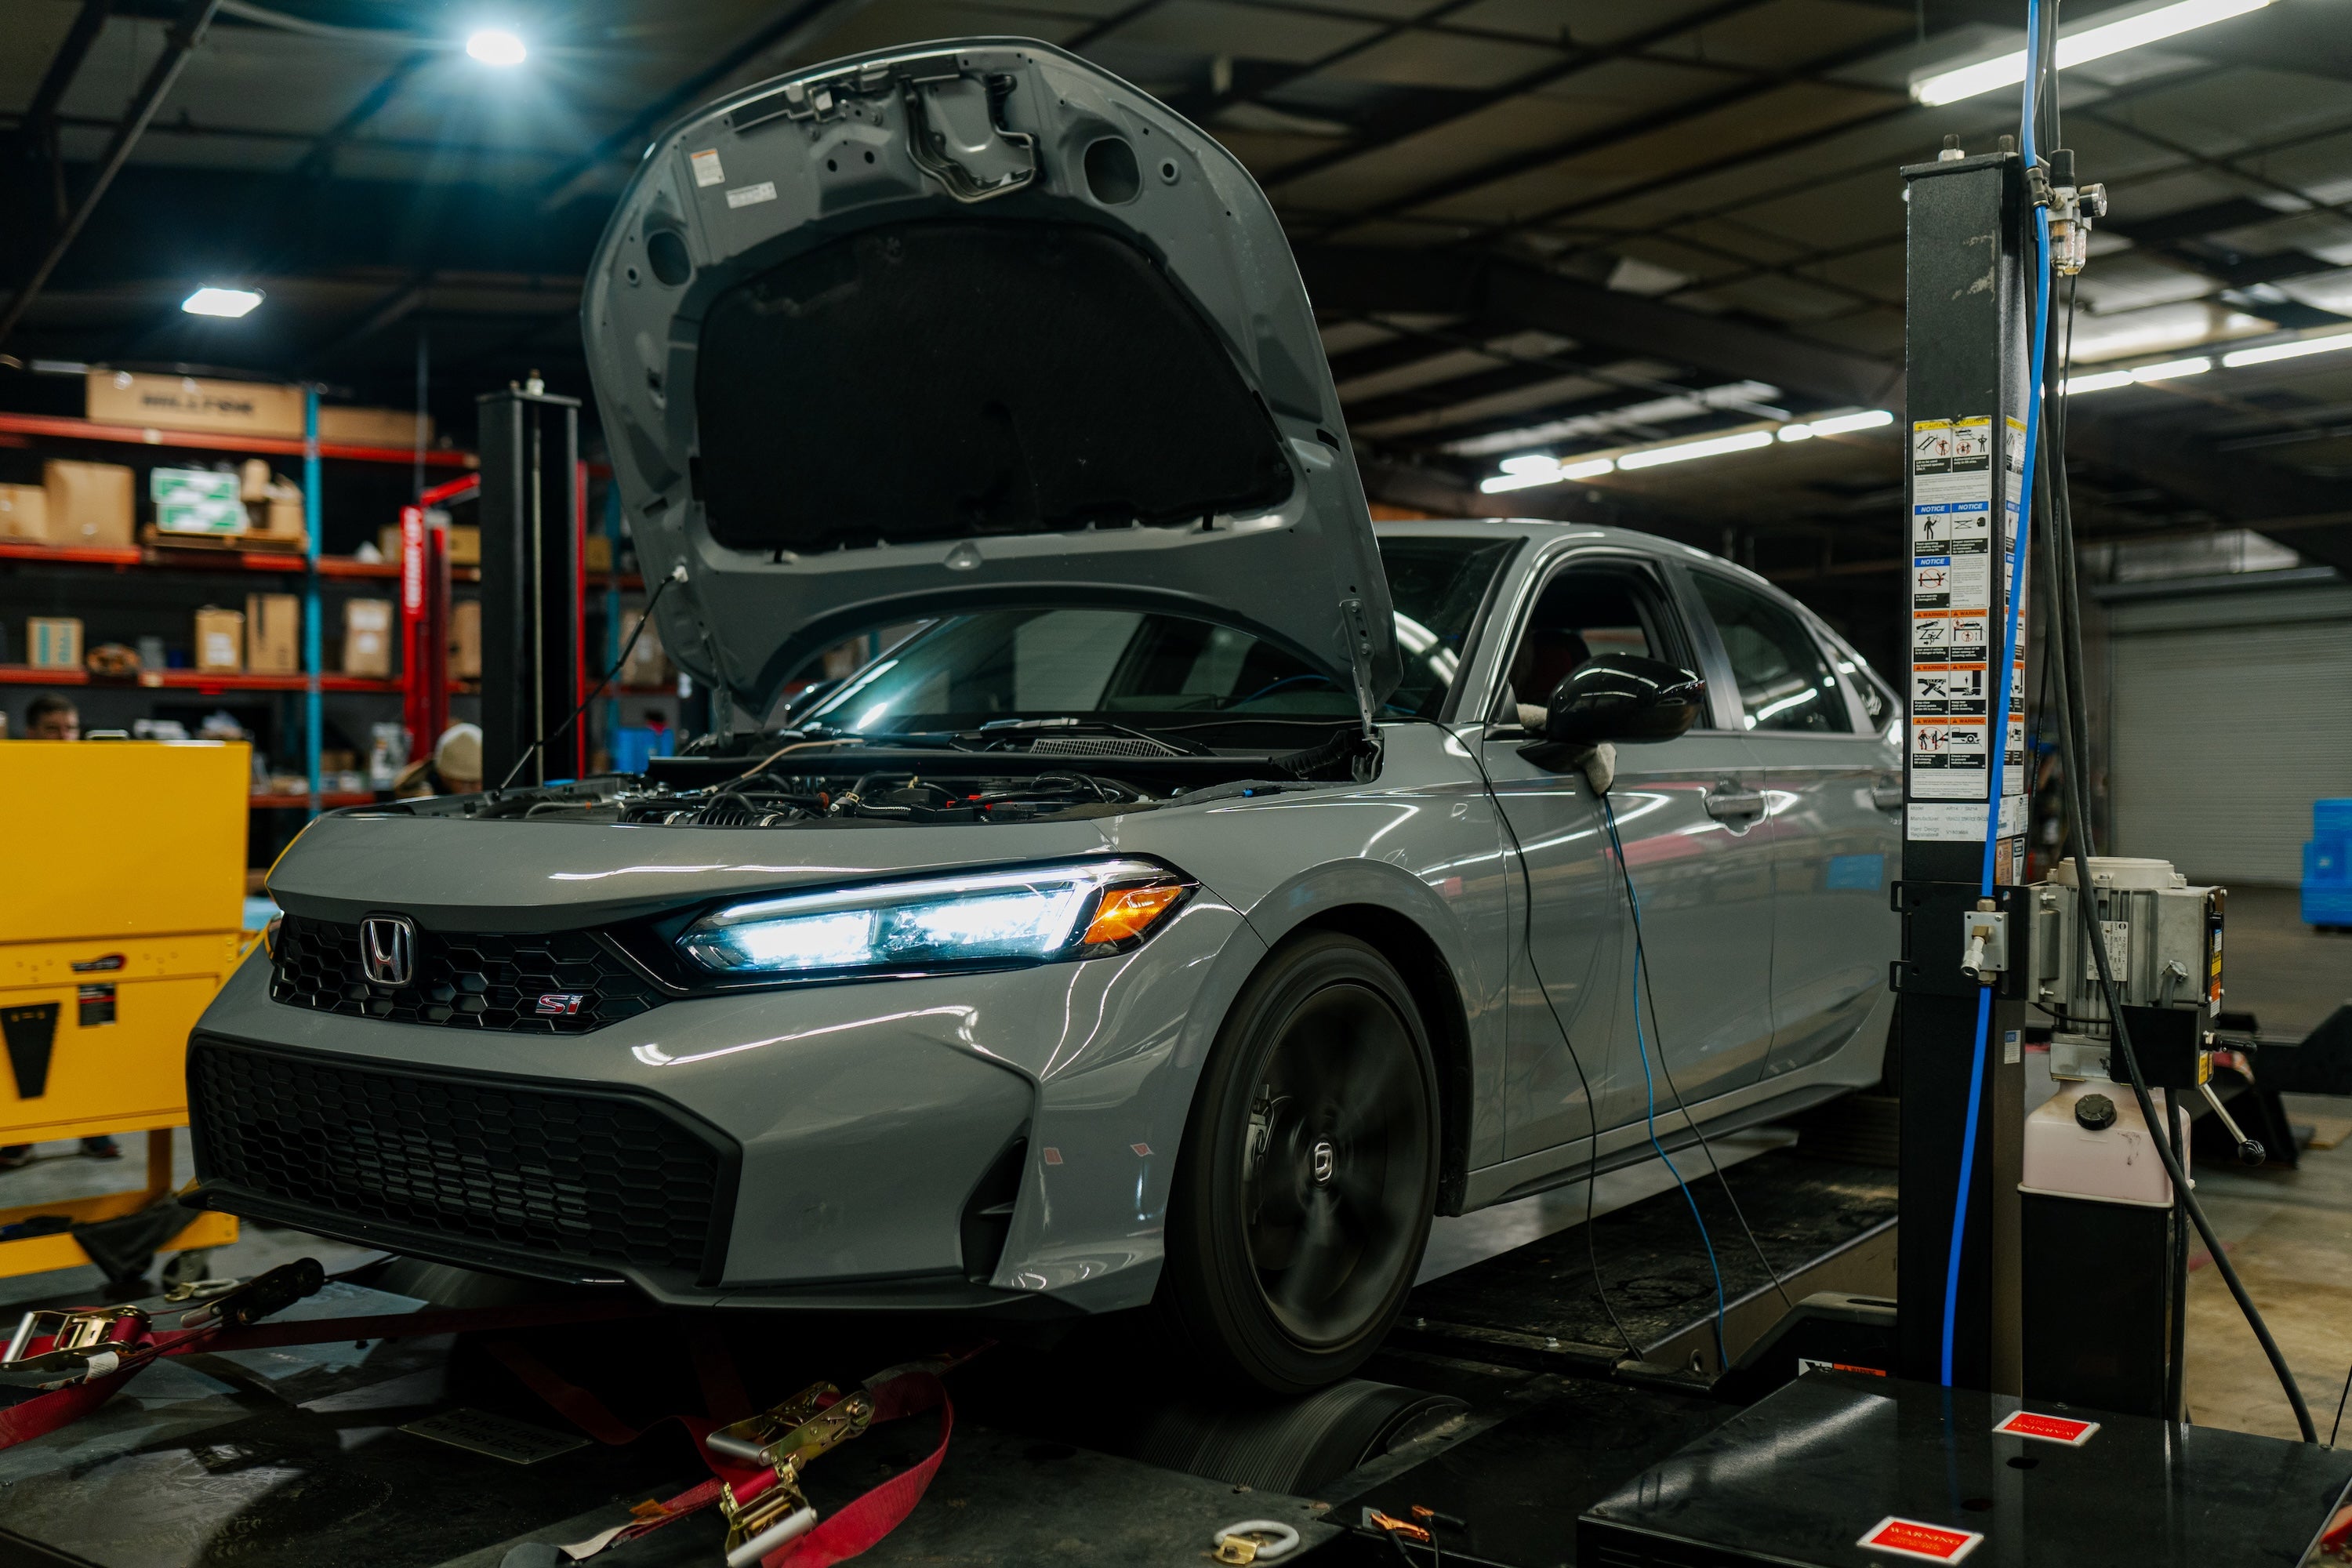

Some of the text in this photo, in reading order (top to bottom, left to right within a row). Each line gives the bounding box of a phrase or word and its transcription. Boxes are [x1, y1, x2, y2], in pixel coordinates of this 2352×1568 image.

[535, 993, 583, 1015] Si
[423, 1421, 543, 1457] ON THIS DECK
[445, 1412, 572, 1448] DO NOT DRIVE
[2011, 1421, 2074, 1437] WARNING
[1889, 1526, 1962, 1546] WARNING
